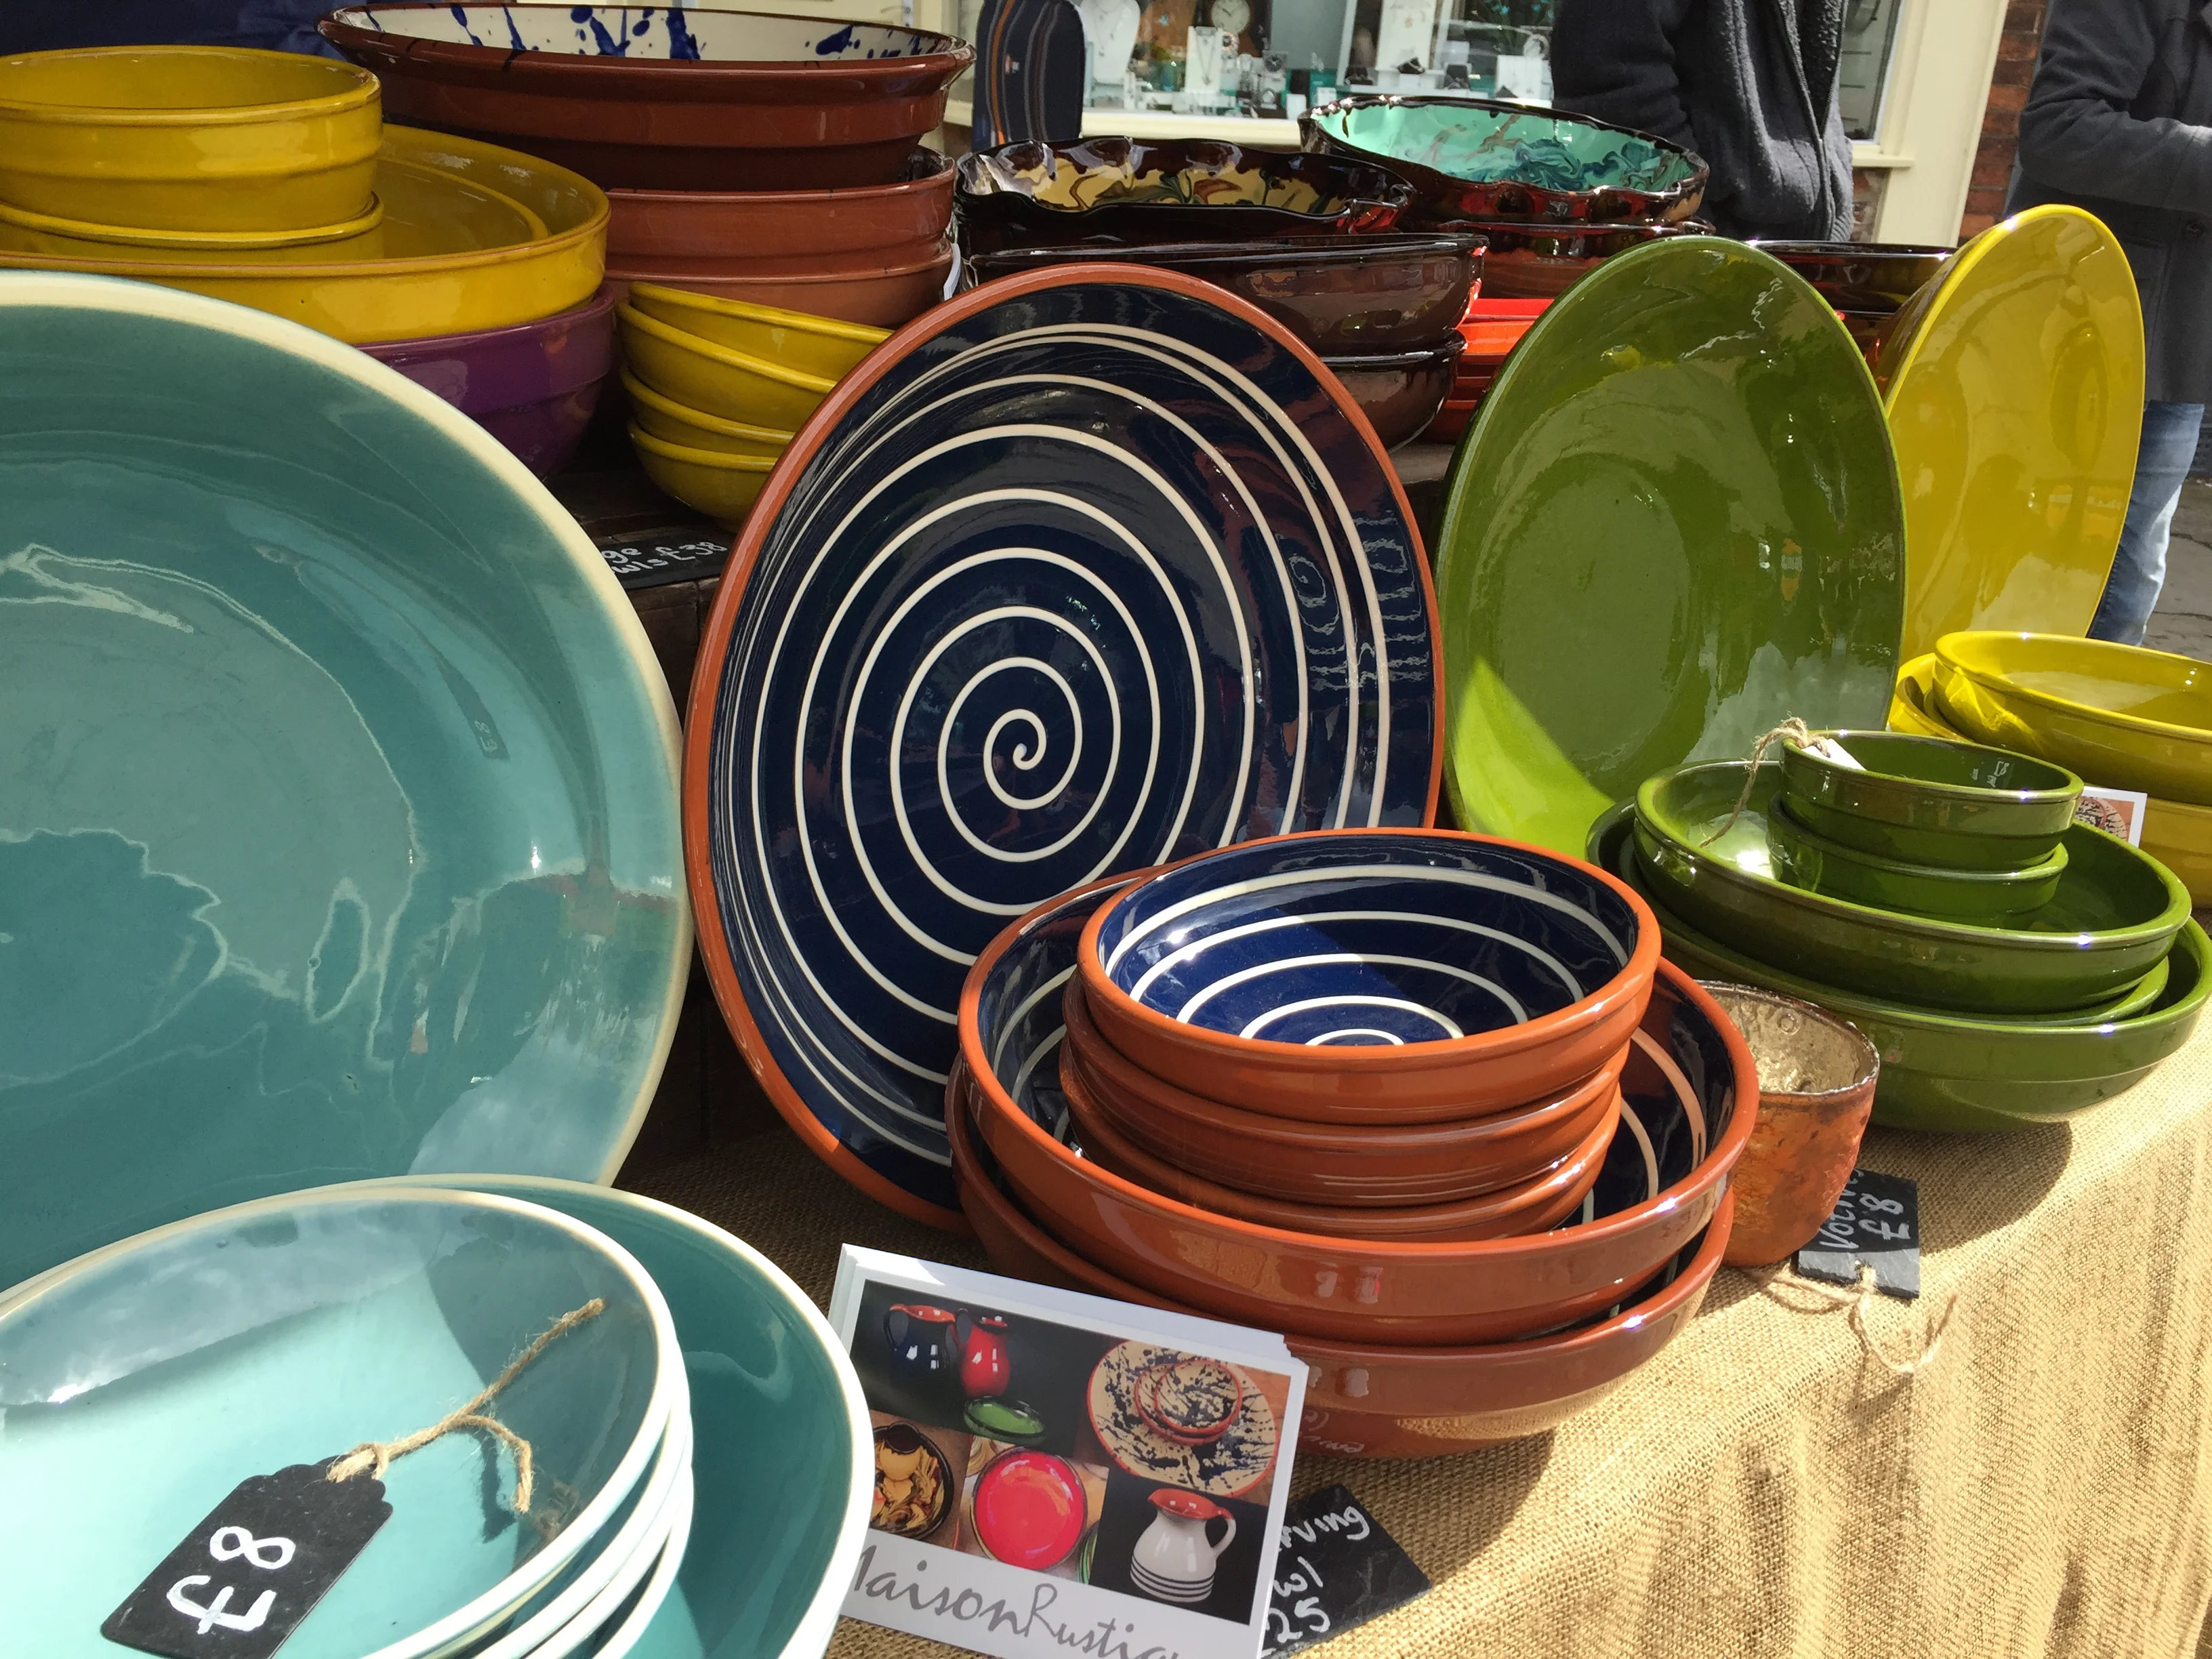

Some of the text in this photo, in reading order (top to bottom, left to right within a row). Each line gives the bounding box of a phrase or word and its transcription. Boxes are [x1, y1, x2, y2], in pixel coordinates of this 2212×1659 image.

[655, 541, 728, 560] £38
[1858, 1192, 1911, 1241] £8
[167, 1525, 296, 1635] £8
[1261, 1596, 1331, 1658] 25
